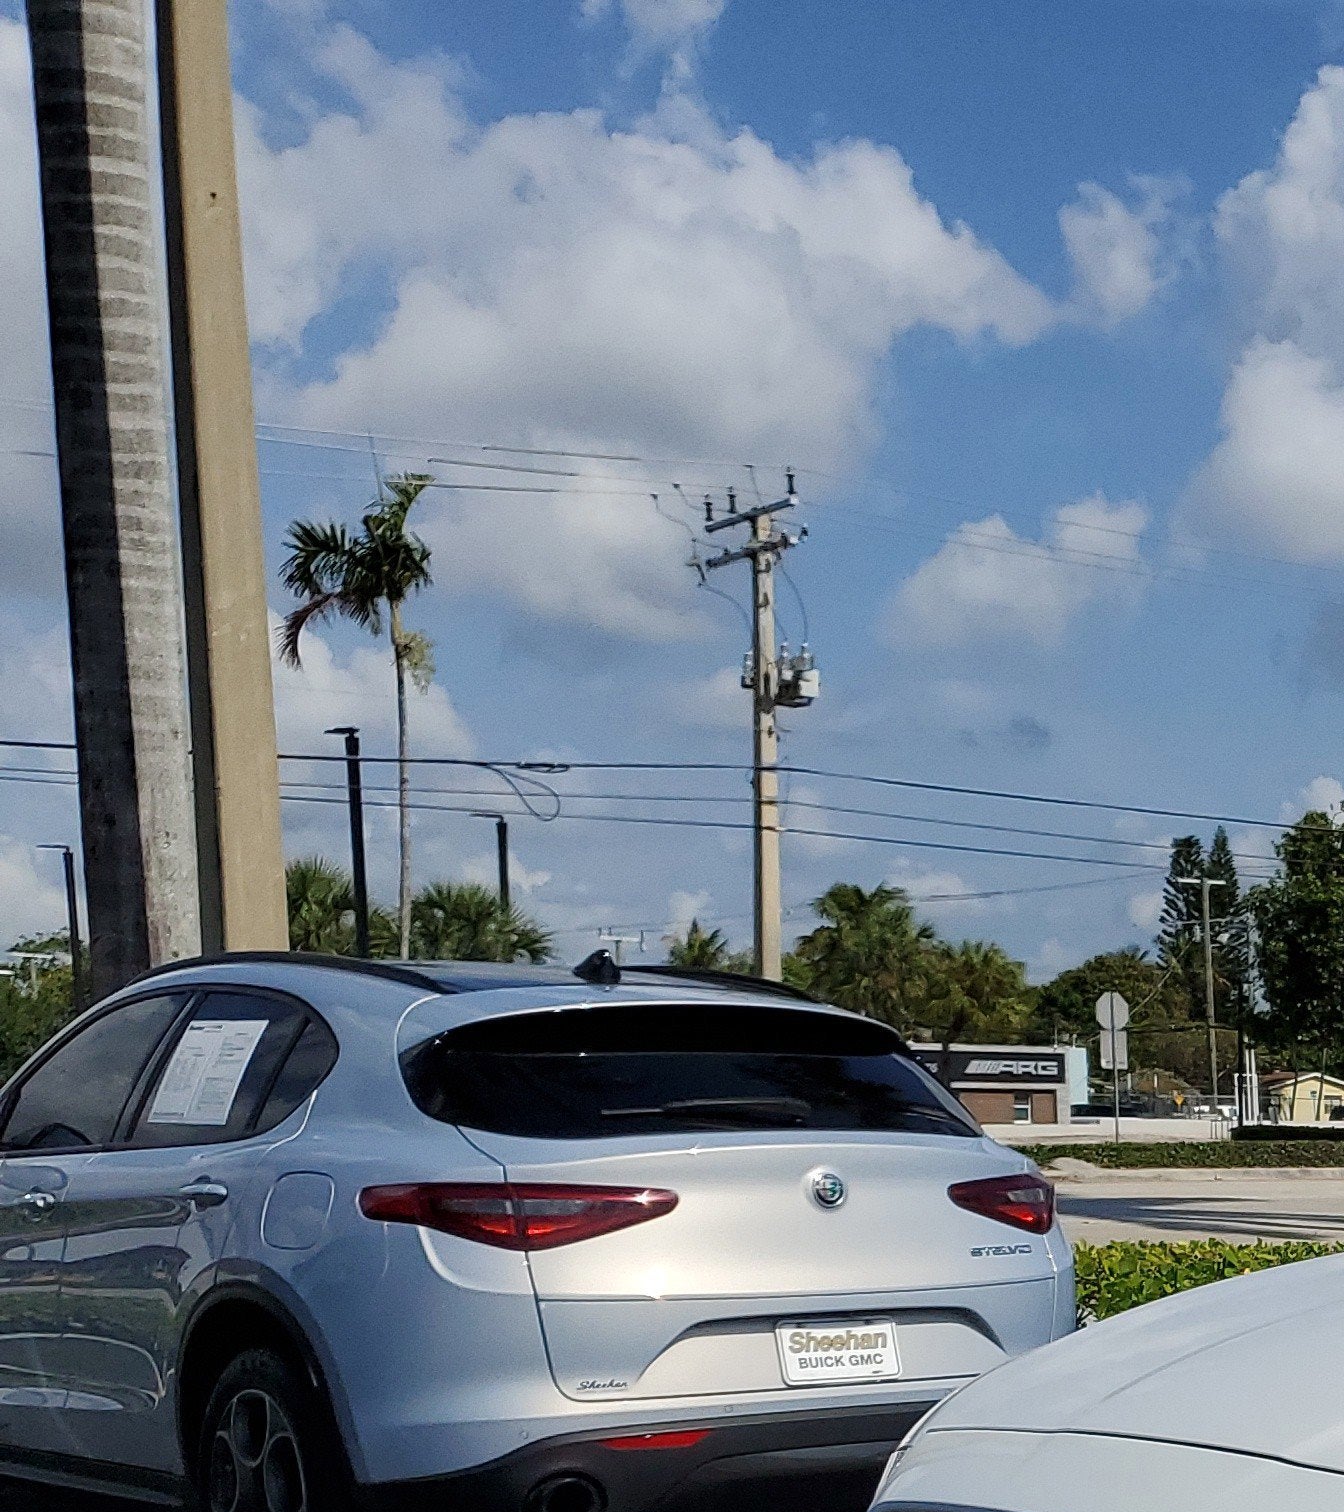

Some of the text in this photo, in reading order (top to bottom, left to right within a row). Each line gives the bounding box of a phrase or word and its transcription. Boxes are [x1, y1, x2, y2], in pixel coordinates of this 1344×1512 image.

[788, 1330, 888, 1354] Sheehan
[798, 1353, 884, 1369] BUICK GMC
